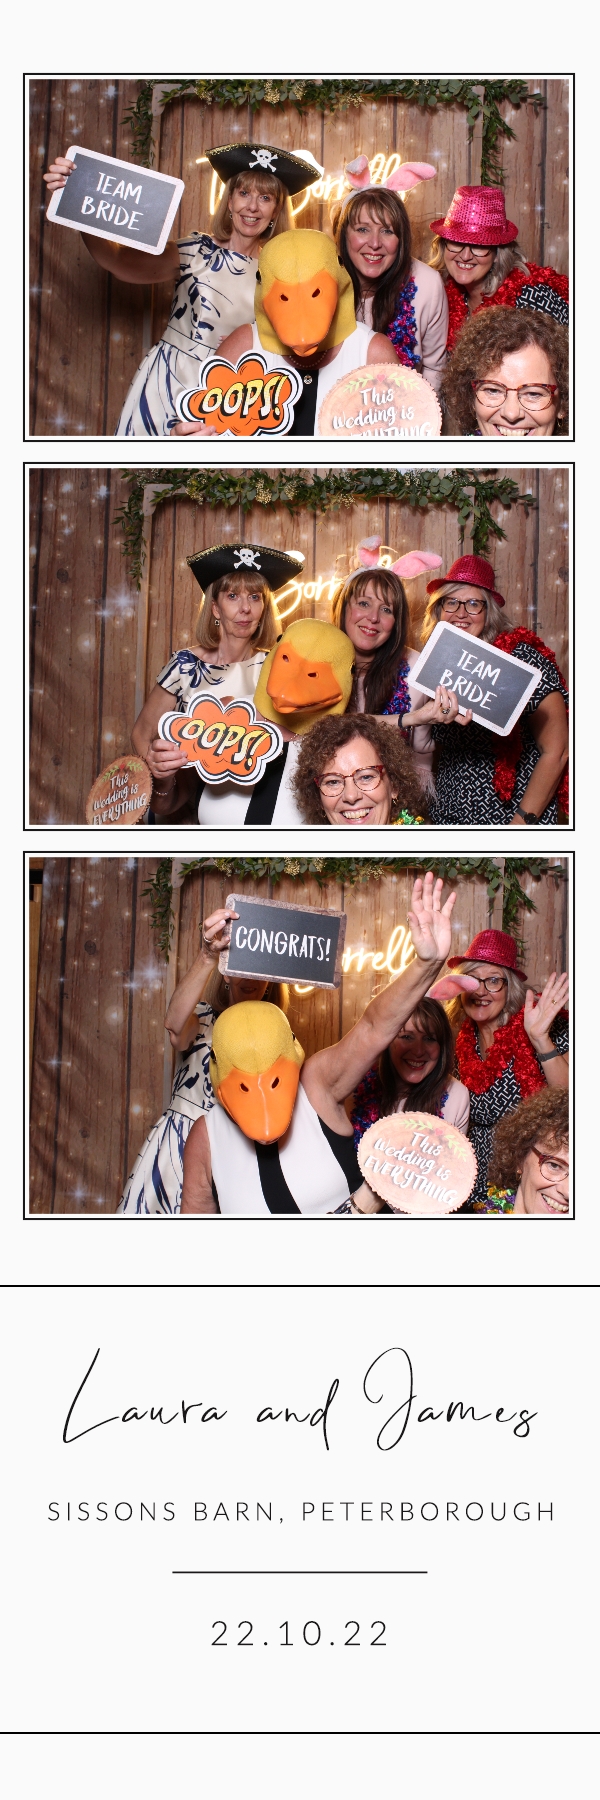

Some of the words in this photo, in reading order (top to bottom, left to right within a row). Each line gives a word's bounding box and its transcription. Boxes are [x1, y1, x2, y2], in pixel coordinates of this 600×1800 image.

[96, 171, 143, 205] TEAM
[80, 195, 144, 231] BRIDE
[198, 374, 290, 421] OOPS!
[359, 386, 395, 406] This
[332, 406, 396, 430] Wedding
[401, 405, 416, 421] is
[456, 648, 501, 686] TEAM
[439, 668, 498, 710] BRIDE
[177, 718, 273, 771] OOPS!
[93, 785, 128, 811] Wedding
[130, 783, 140, 796] is
[110, 772, 129, 790] This
[93, 792, 148, 825] EVERYTHING
[235, 925, 331, 962] CONGRATS!
[374, 1137, 437, 1175] Wedding
[436, 1164, 453, 1181] is
[411, 1131, 443, 1157] This
[363, 1155, 459, 1206] EVERYTHING
